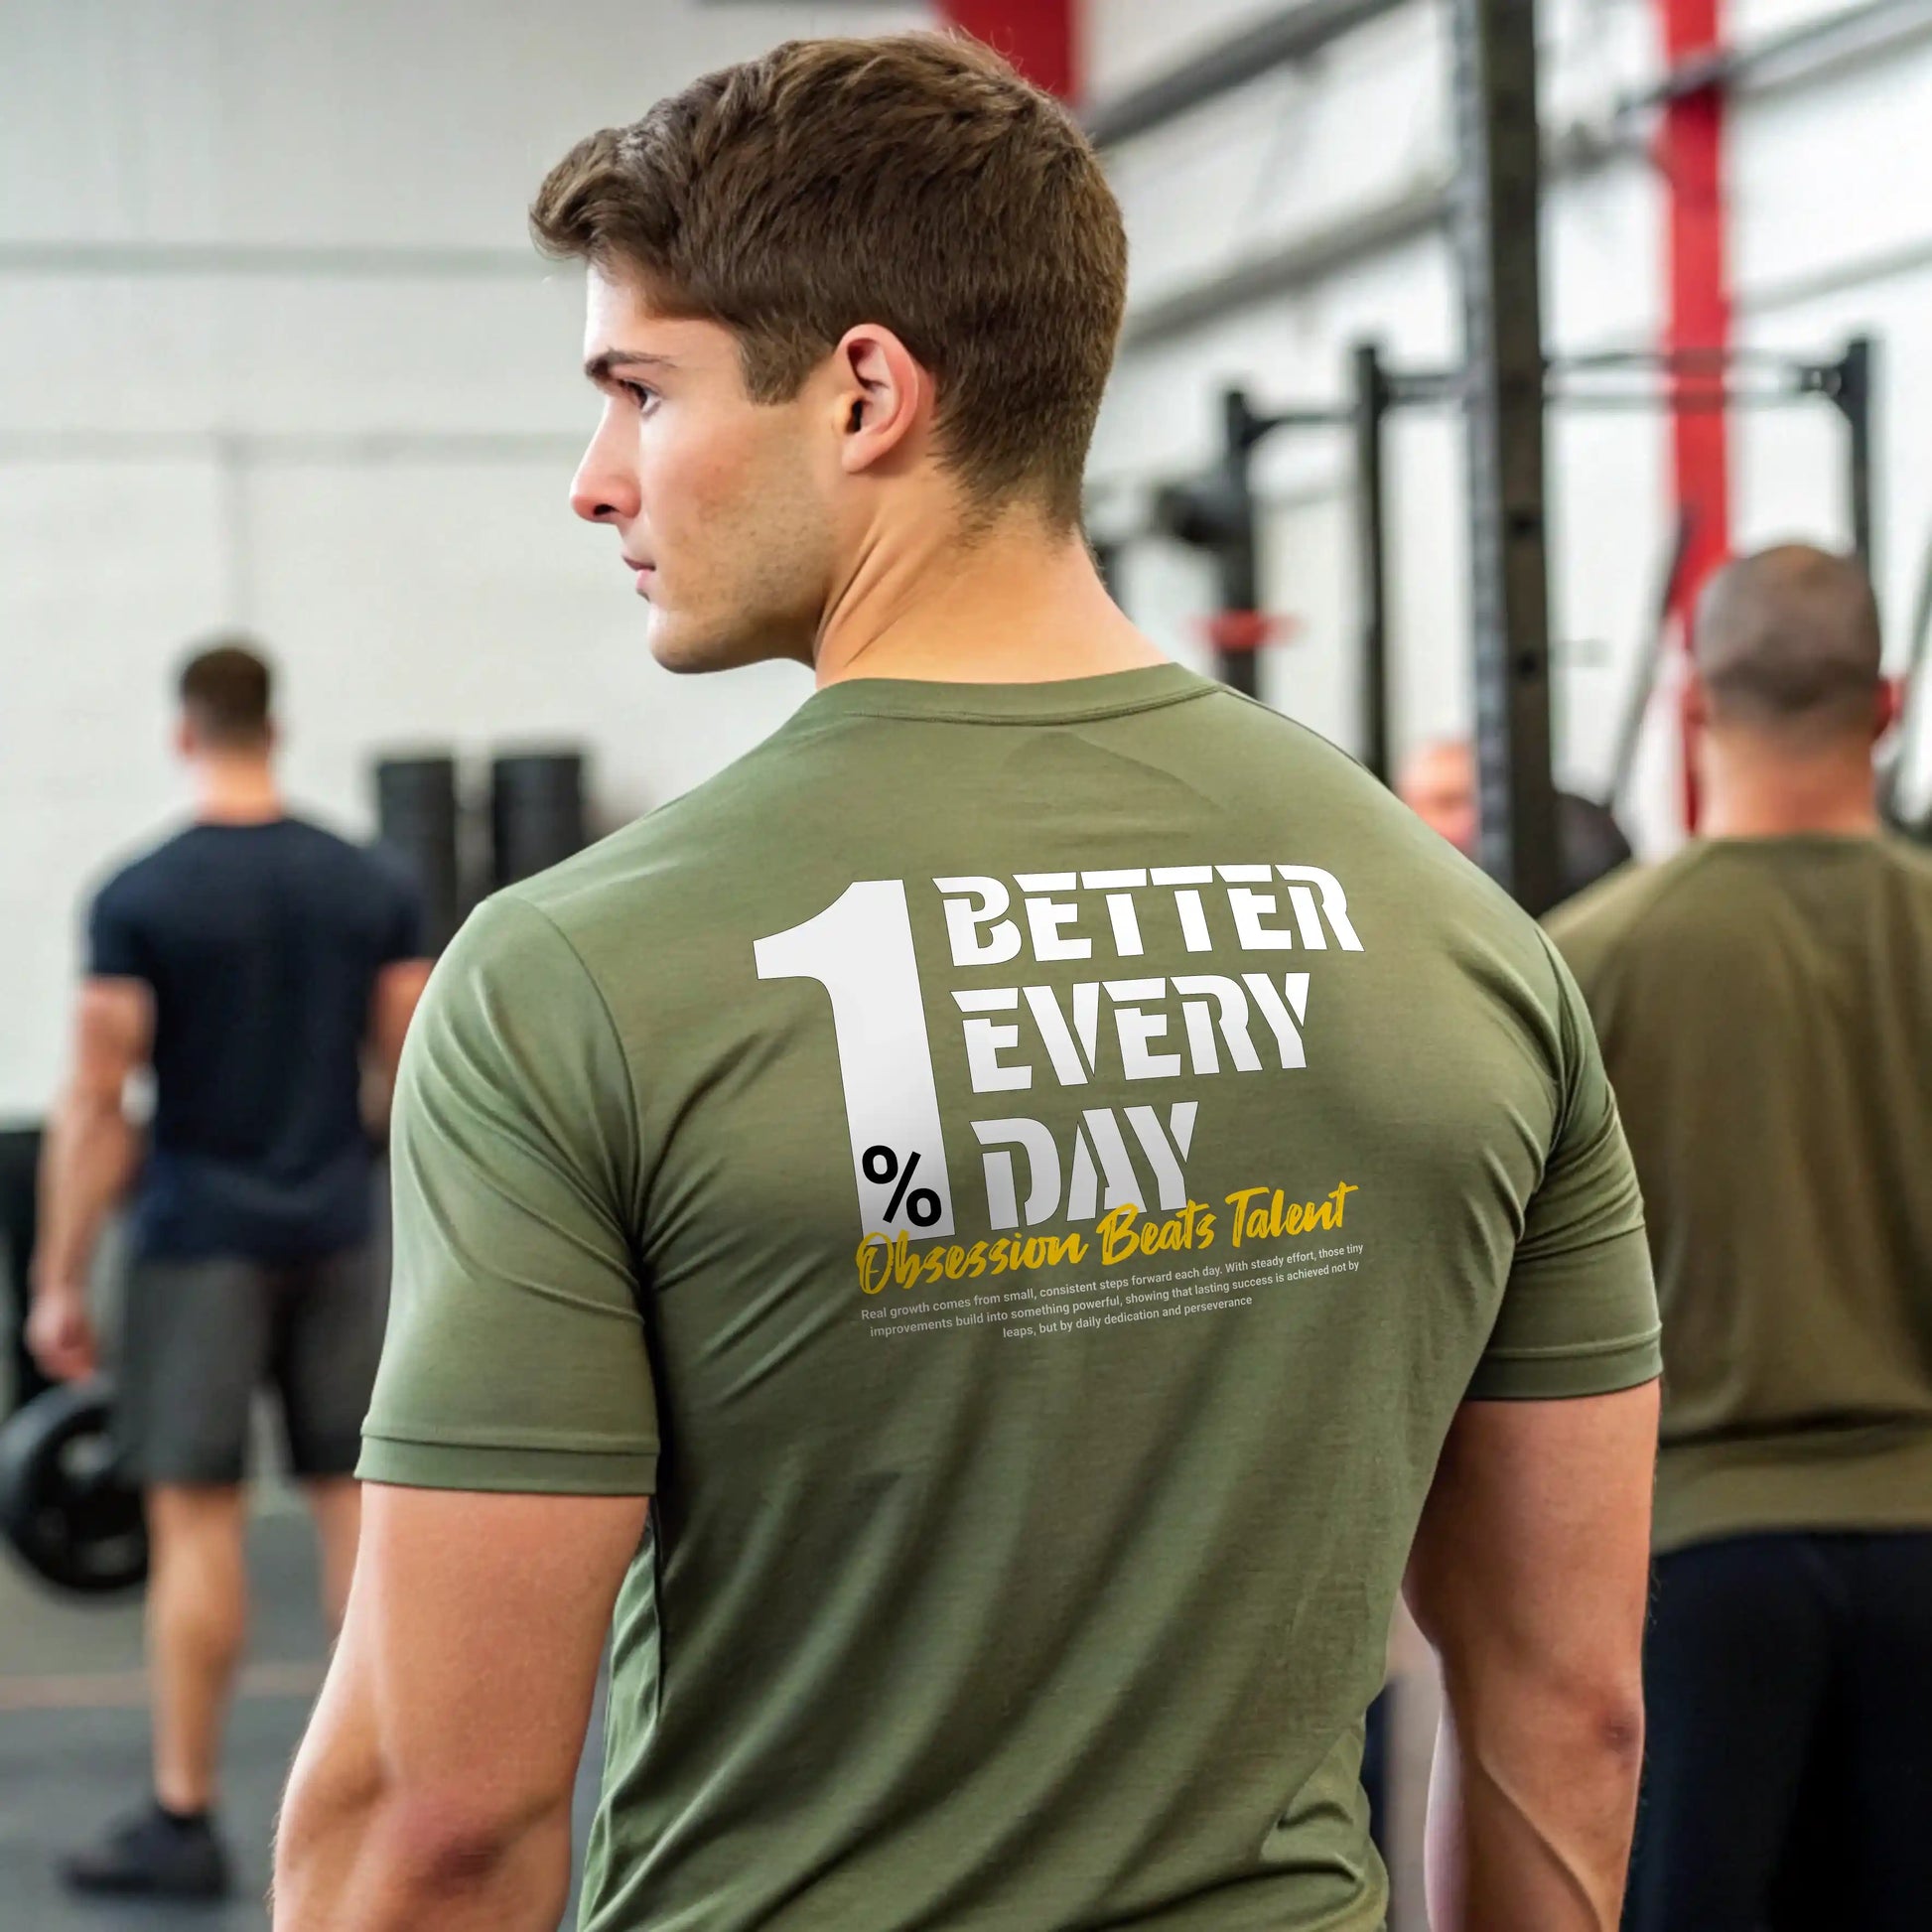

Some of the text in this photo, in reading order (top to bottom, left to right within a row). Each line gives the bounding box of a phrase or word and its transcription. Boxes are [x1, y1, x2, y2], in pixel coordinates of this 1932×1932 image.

[931, 864, 1365, 967] BETTER
[950, 972, 1311, 1093] EVERY
[969, 1100, 1198, 1231] DAY
[855, 1180, 1359, 1295] Obsession Beats Talent
[861, 1243, 1364, 1320] Real growth comes from small, consistent steps forward each day. With steady effort, those tiny
[870, 1260, 1360, 1338] improvements build into something powerful, showing that lasting success is achieved not by
[1003, 1296, 1253, 1338] leaps, but by daily dedication and perseverance
